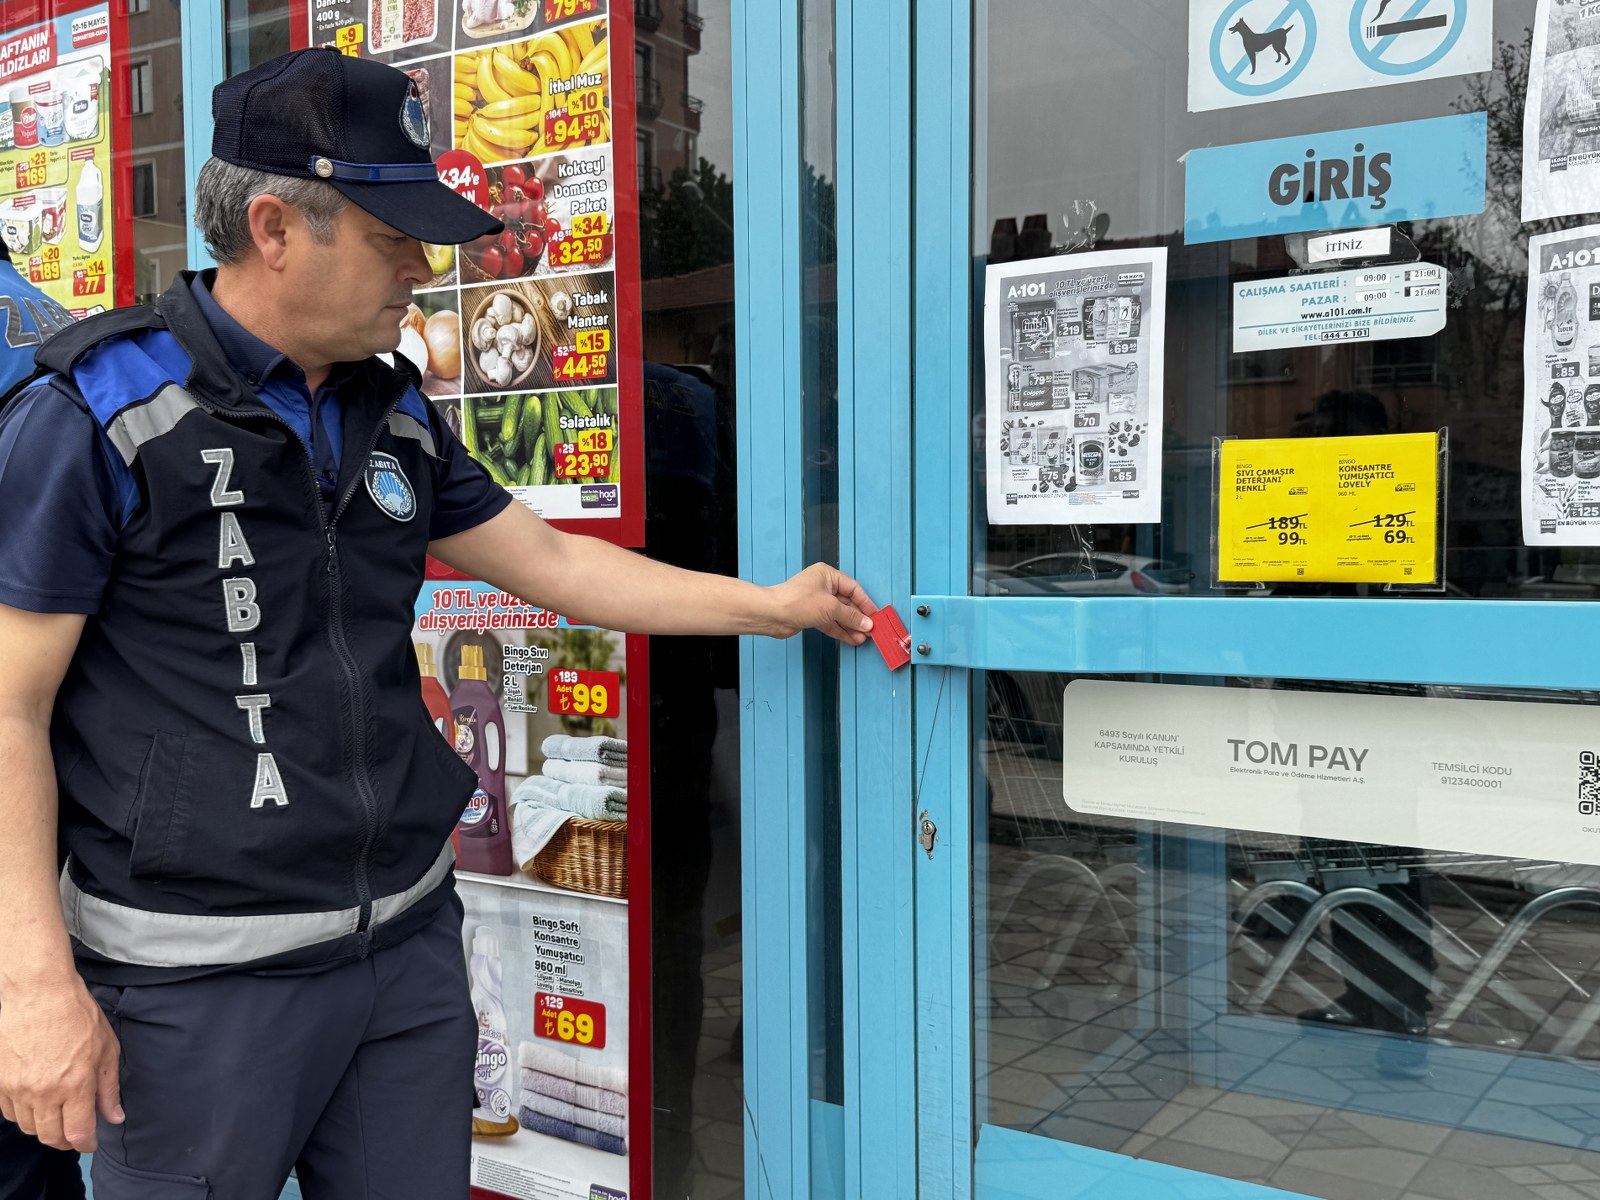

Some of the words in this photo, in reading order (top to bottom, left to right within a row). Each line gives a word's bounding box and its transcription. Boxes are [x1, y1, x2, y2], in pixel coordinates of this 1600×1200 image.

[316, 10, 334, 22] 400
[334, 10, 340, 21] g
[1580, 9, 1586, 18] 1
[342, 27, 356, 43] %9
[576, 73, 602, 90] Muz
[572, 92, 598, 111] %10
[557, 157, 605, 178] Kokteyl
[1268, 142, 1392, 210] GİRİŞ
[553, 180, 607, 199] Domates
[570, 198, 606, 216] Paket
[574, 215, 603, 235] %34
[1325, 239, 1363, 253] İTİNİZ
[588, 251, 602, 260] Adet
[89, 260, 105, 274] %14
[1055, 280, 1065, 289] 10
[1238, 286, 1286, 300] ÇALIŞMA
[1289, 277, 1340, 293] SAATLERİ
[1363, 273, 1387, 282] 09:00
[1414, 269, 1436, 278] 21:00
[572, 290, 608, 307] Tabak
[1301, 294, 1340, 307] PAZAR
[1363, 291, 1387, 302] 09:00
[1300, 306, 1372, 320] www.a101.com.tr
[567, 314, 609, 330] Mantar
[1258, 327, 1278, 336] DİLEK
[1280, 327, 1290, 335] VE
[1354, 318, 1371, 328] BİZE
[580, 332, 605, 351] %15
[1323, 331, 1341, 340] 444
[1352, 329, 1368, 338] 101
[592, 367, 605, 376] Adet
[559, 414, 611, 429] Salatalık
[581, 432, 608, 450] %18
[369, 459, 398, 470] ZABITA
[596, 468, 605, 476] Kg
[1338, 463, 1392, 473] KONSANTRE
[1236, 469, 1255, 477] SIVI
[1256, 468, 1295, 477] ÇAMAŞIR
[1338, 472, 1395, 481] YUMUŞATICI
[1236, 476, 1282, 485] DETERJANI
[1236, 484, 1267, 492] RENKLİ
[1338, 480, 1371, 489] LOVELY
[432, 589, 453, 609] 10
[455, 589, 476, 608] TL
[478, 594, 497, 608] ve
[200, 447, 290, 809] ZABITA
[419, 608, 559, 636] alışverişlerinizde
[504, 645, 529, 660] Bingo
[530, 646, 548, 658] Sıvı
[504, 660, 542, 674] Deterjan
[504, 676, 511, 686] 2
[512, 676, 518, 687] L
[556, 684, 573, 694] Adet
[1099, 729, 1120, 738] 6493
[1121, 730, 1144, 742] Sayılı
[1094, 740, 1151, 753] KAPSAMINDA
[1152, 745, 1185, 756] YETKİLİ
[1227, 738, 1298, 767] TOM
[1308, 744, 1369, 772] PAY
[1119, 754, 1159, 767] KURULUŞ
[1229, 766, 1262, 775] Elektronik
[1263, 769, 1280, 778] Para
[1290, 771, 1316, 780] Ödeme
[1316, 774, 1351, 783] Hizmetleri
[1352, 776, 1366, 785] A.Ş.
[1432, 761, 1480, 774] TEMSİLCİ
[1482, 766, 1512, 776] KODU
[1440, 776, 1502, 789] 9123400001
[532, 915, 558, 930] Bingo
[559, 920, 580, 933] Soft
[533, 930, 579, 948] Konsantre
[534, 945, 584, 963] Yumuşatıcı
[534, 960, 553, 973] 960
[554, 963, 567, 975] ml
[541, 1008, 558, 1019] Adet
[475, 1050, 506, 1070] ingo
[477, 1068, 492, 1081] Soft
